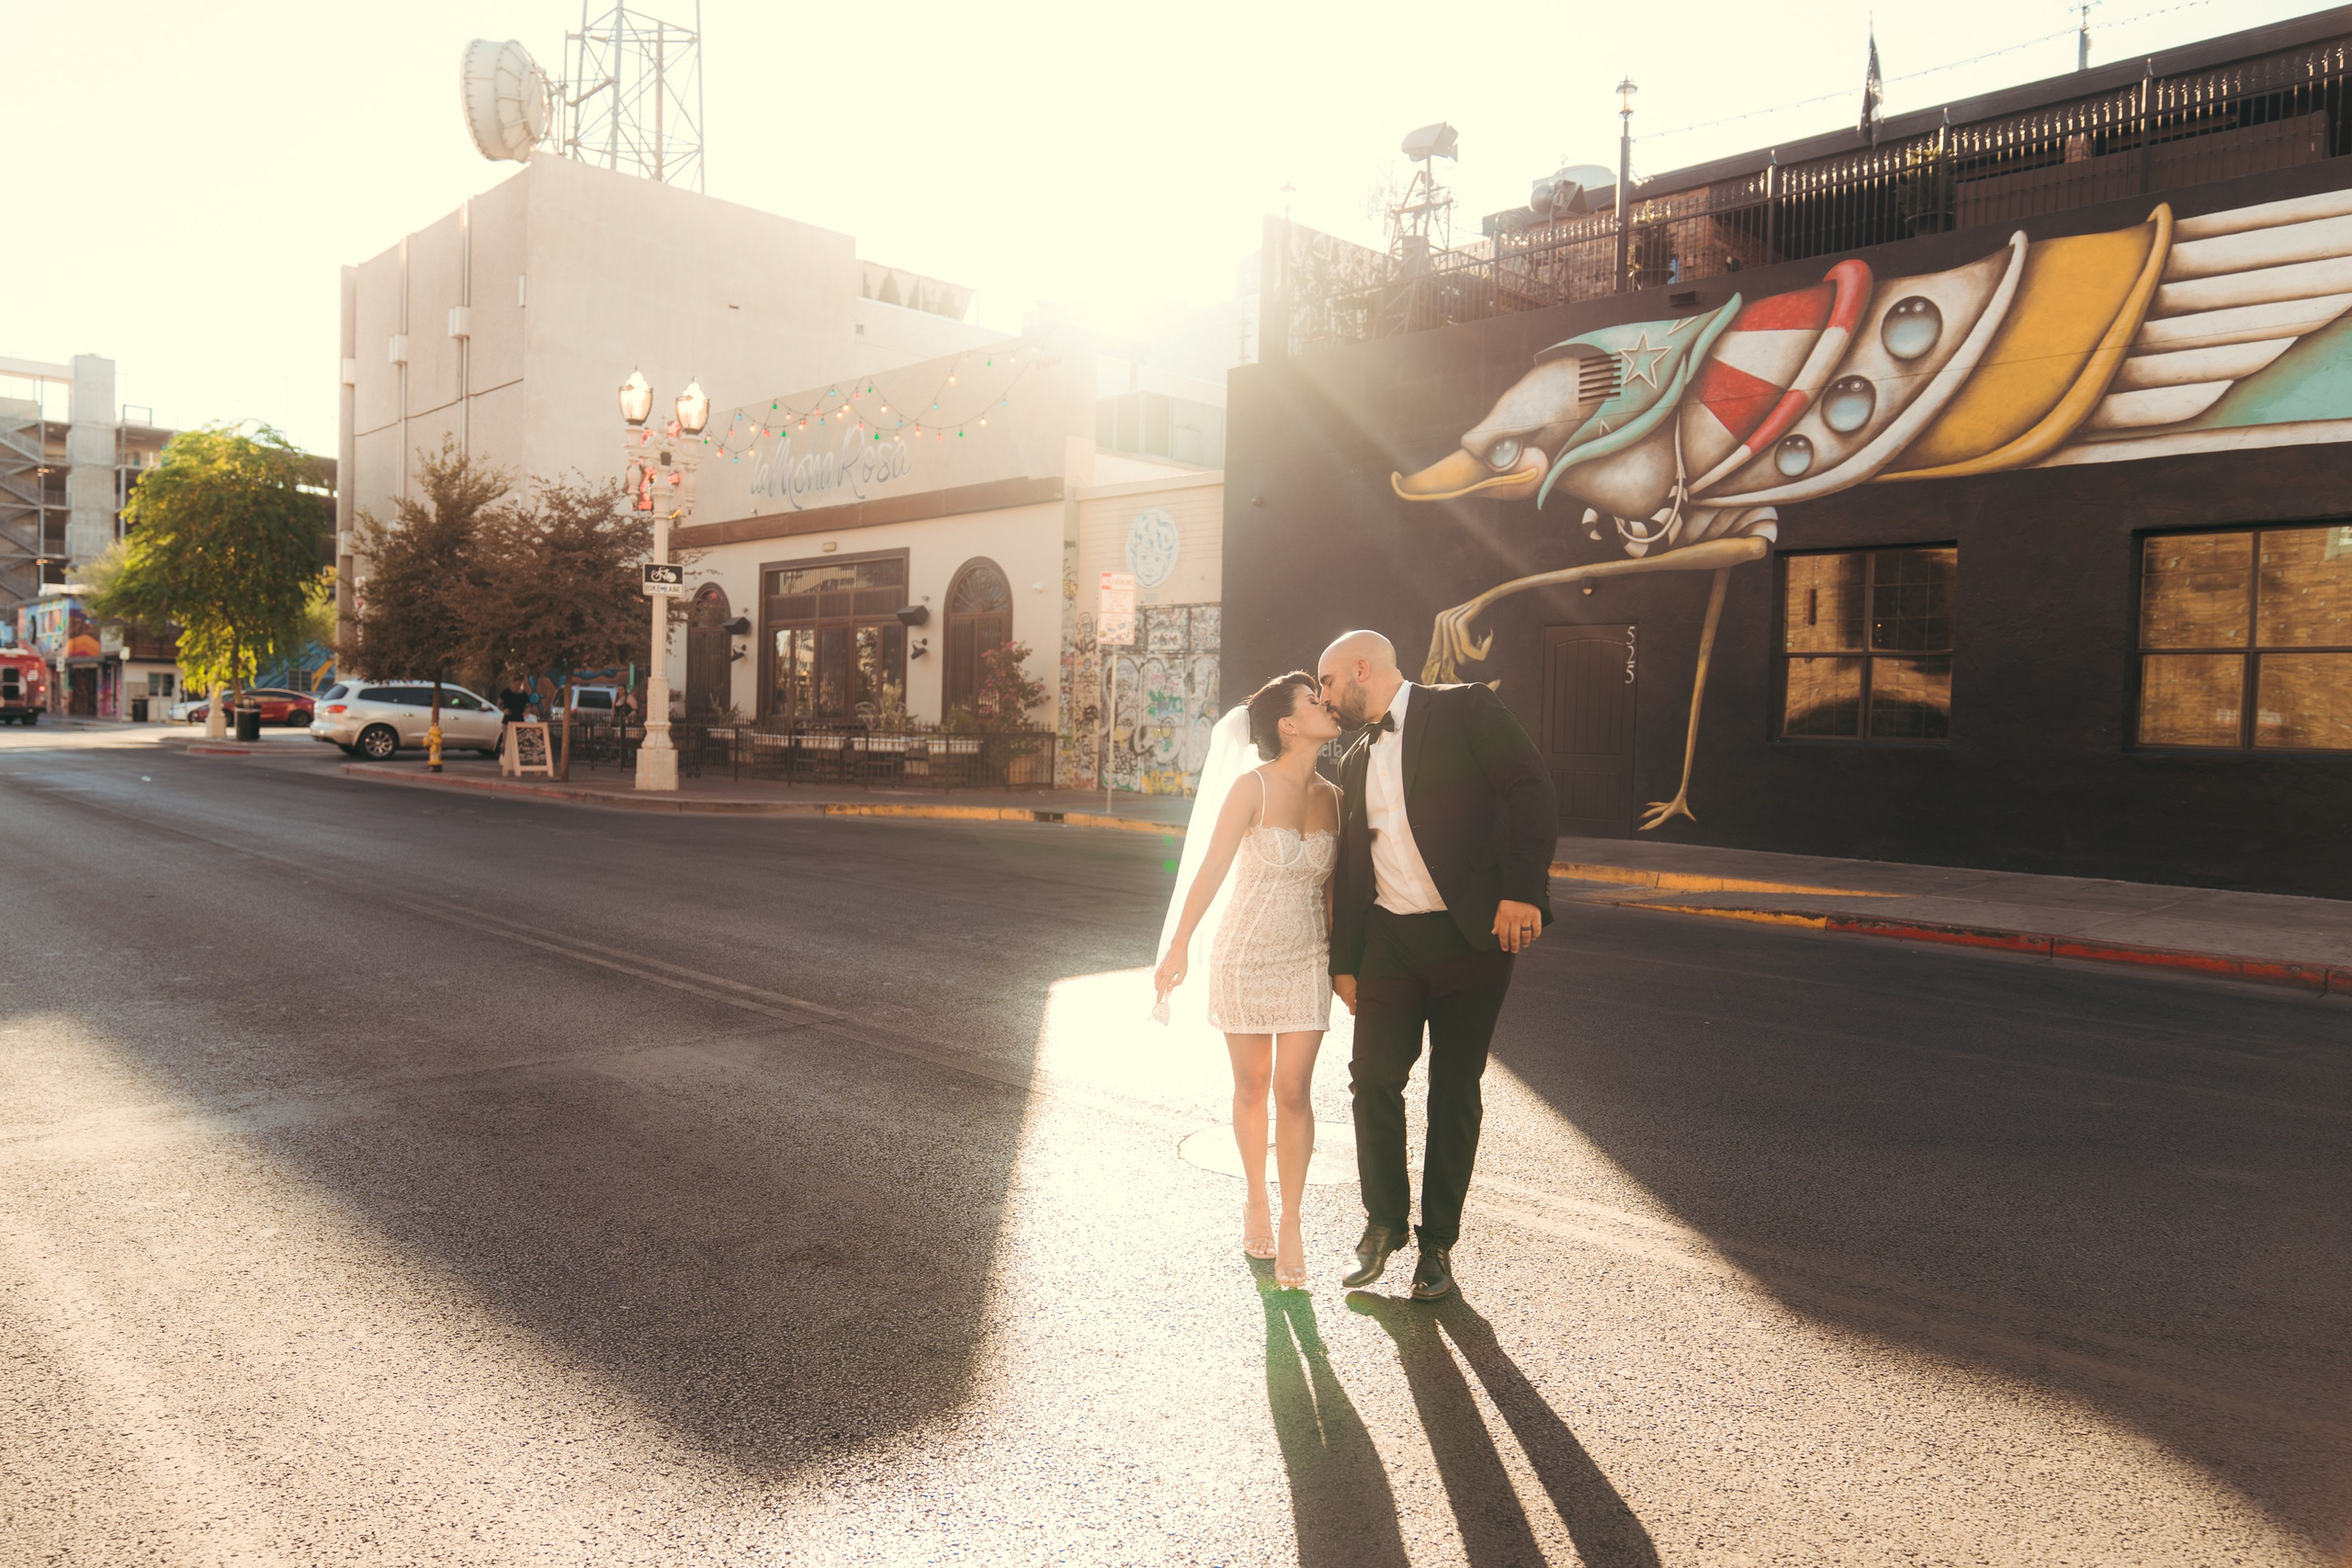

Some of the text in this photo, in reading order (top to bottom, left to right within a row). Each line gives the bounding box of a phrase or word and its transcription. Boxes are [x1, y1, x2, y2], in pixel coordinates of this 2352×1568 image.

[769, 437, 834, 511] Mona
[837, 424, 912, 500] Rosa
[646, 584, 661, 592] BIKE
[1625, 626, 1635, 684] 525
